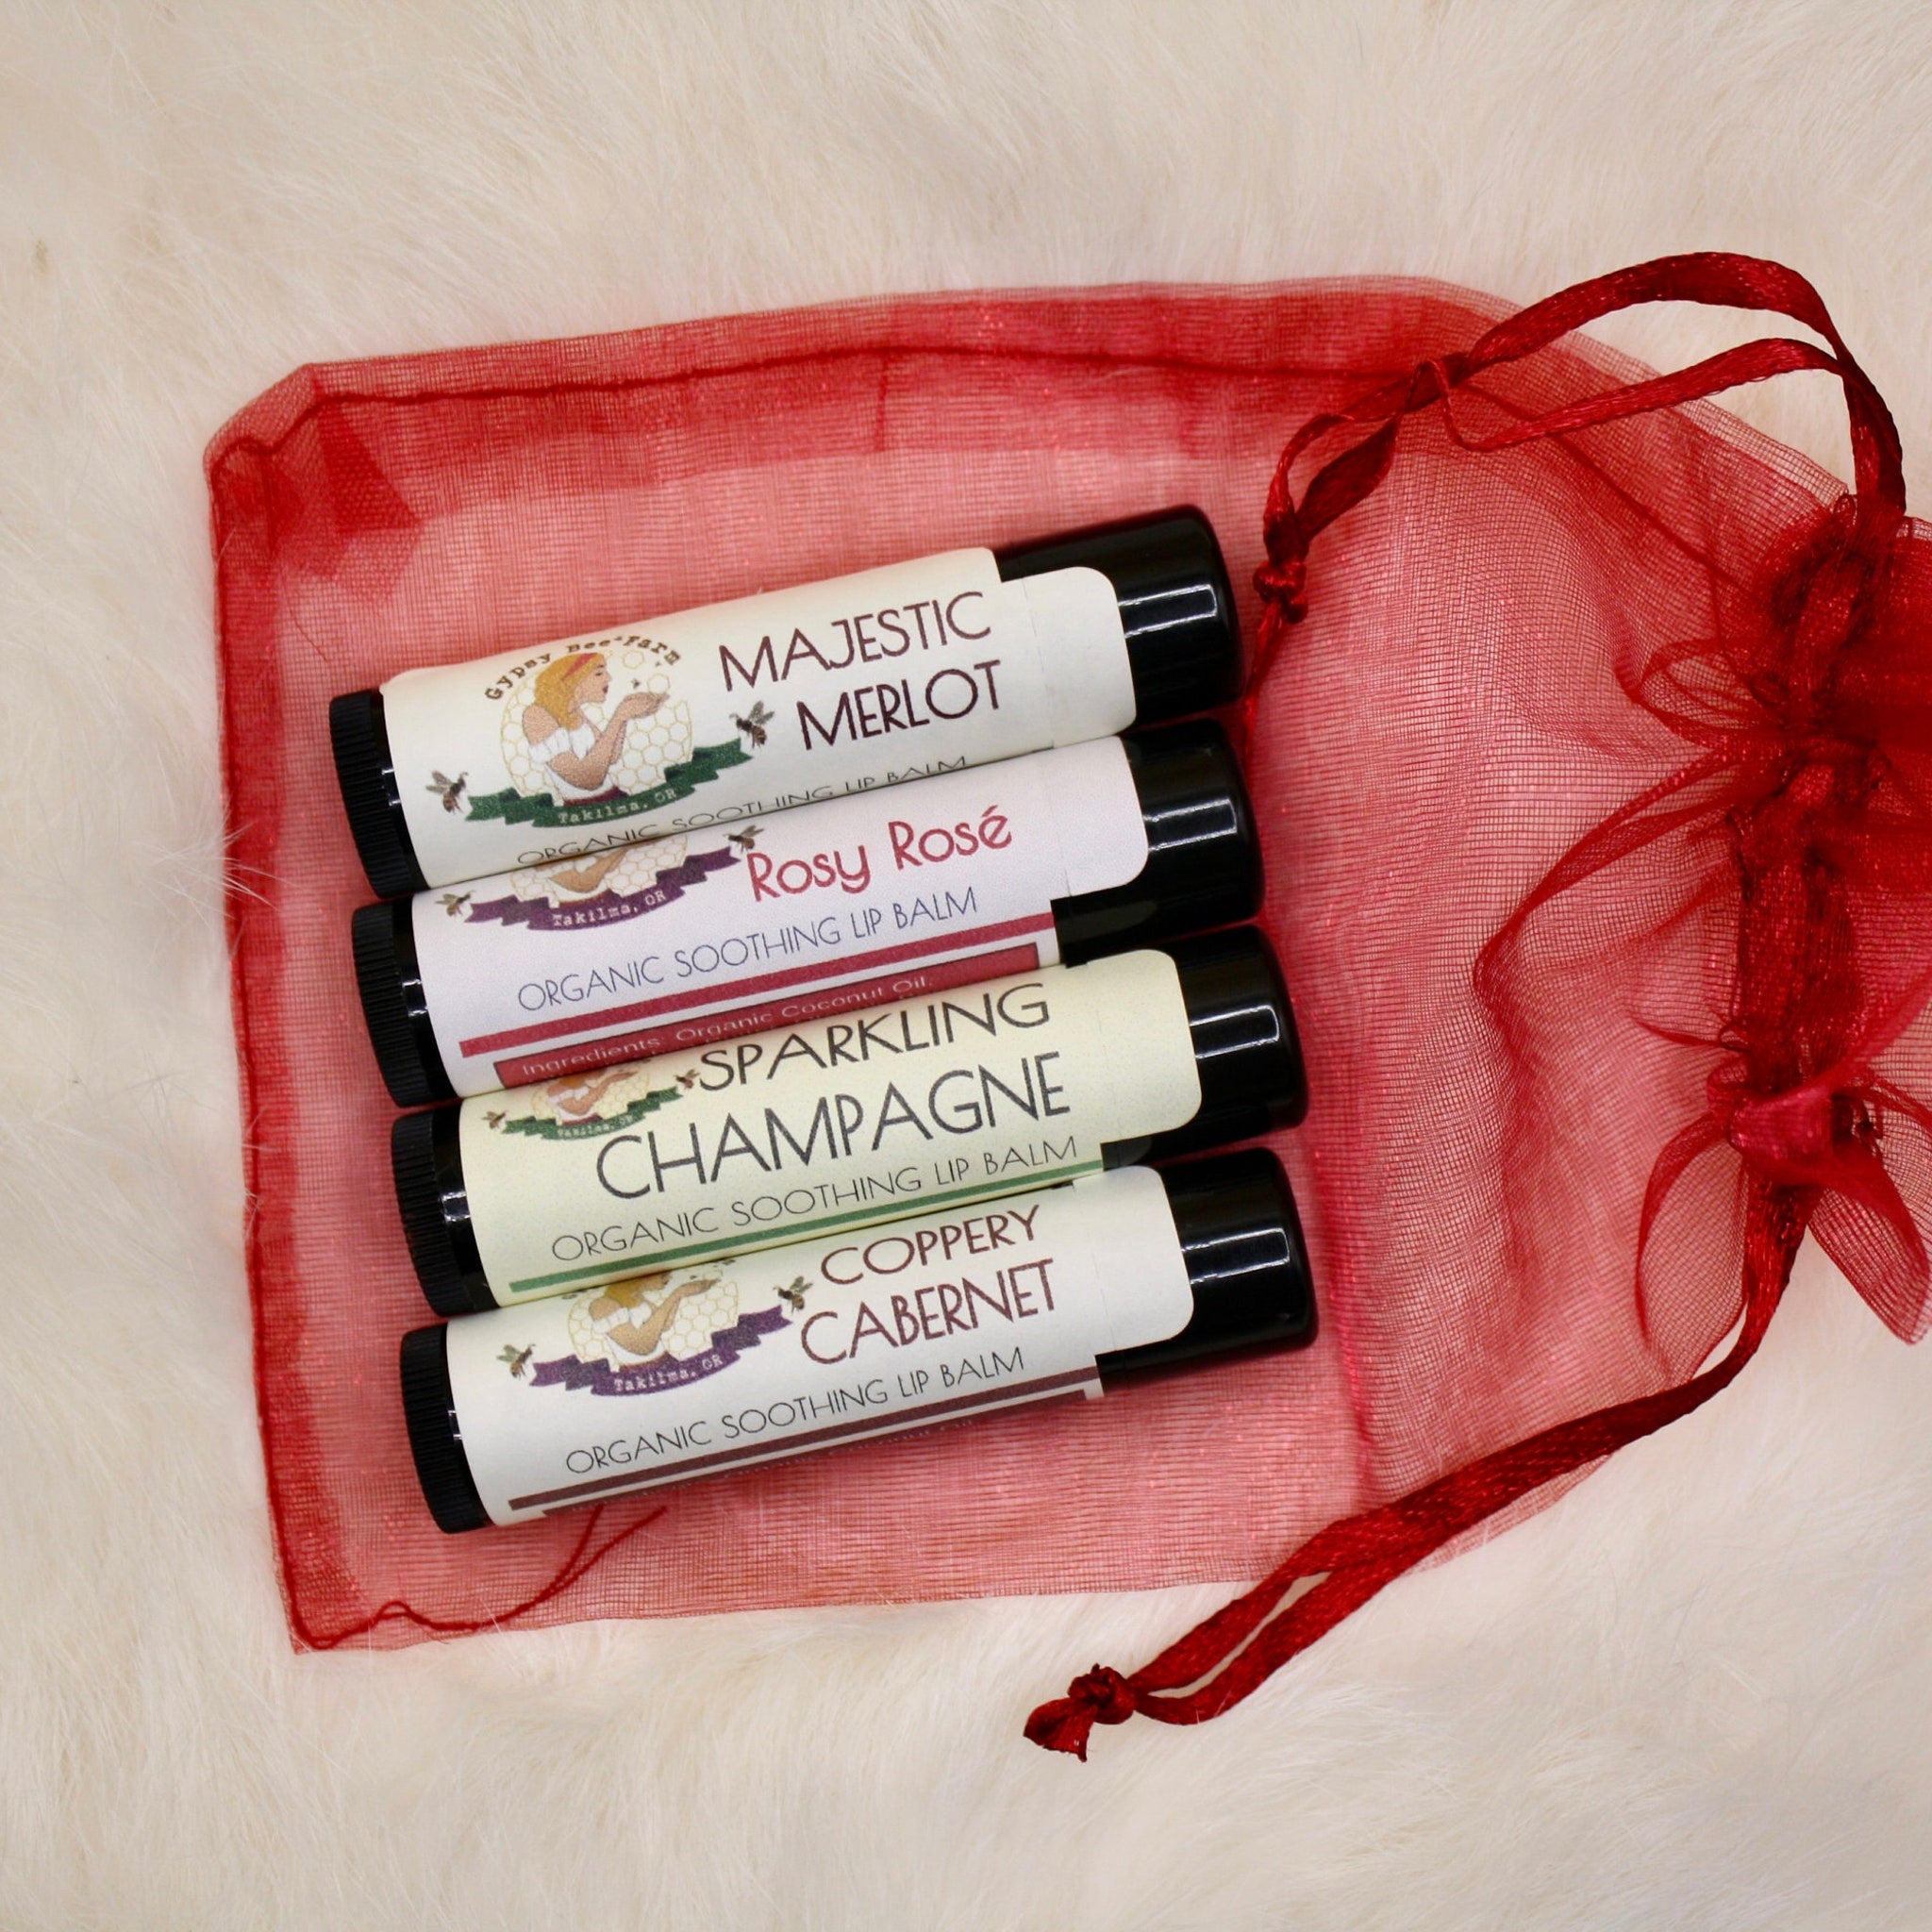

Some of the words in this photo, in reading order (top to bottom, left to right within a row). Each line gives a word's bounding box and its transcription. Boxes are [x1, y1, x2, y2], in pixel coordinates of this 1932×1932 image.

[485, 653, 551, 700] Gypsy
[719, 591, 991, 691] MAJESTIC
[796, 659, 1002, 751] MERLOT
[518, 824, 660, 864] ORGANIC
[673, 785, 833, 831] SOOTHING
[844, 776, 875, 792] LIP
[887, 756, 966, 783] BALM
[655, 789, 677, 804] OR
[644, 889, 667, 906] OR
[746, 845, 870, 903] Rosy
[887, 805, 1013, 871] Rosé
[518, 956, 664, 1012] ORGANIC
[675, 917, 841, 978] SOOTHING
[851, 908, 881, 940] LIP
[891, 887, 978, 929] BALM
[675, 1012, 774, 1042] Organic
[781, 987, 884, 1018] Coconut
[698, 982, 1051, 1092] SPARKLING
[596, 1050, 1072, 1199] CHAMPAGNE
[552, 1205, 718, 1262] ORGANIC
[732, 1166, 922, 1226] SOOTHING
[935, 1157, 970, 1188] LIP
[984, 1135, 1078, 1175] BALM
[821, 1203, 1041, 1286] COPPERY
[800, 1258, 1056, 1364] CABERNET
[565, 1419, 713, 1474] ORGANIC
[722, 1377, 890, 1439] SOOTHING
[898, 1370, 931, 1399] LIP
[943, 1347, 1026, 1390] BALM
[702, 1353, 724, 1370] OR
